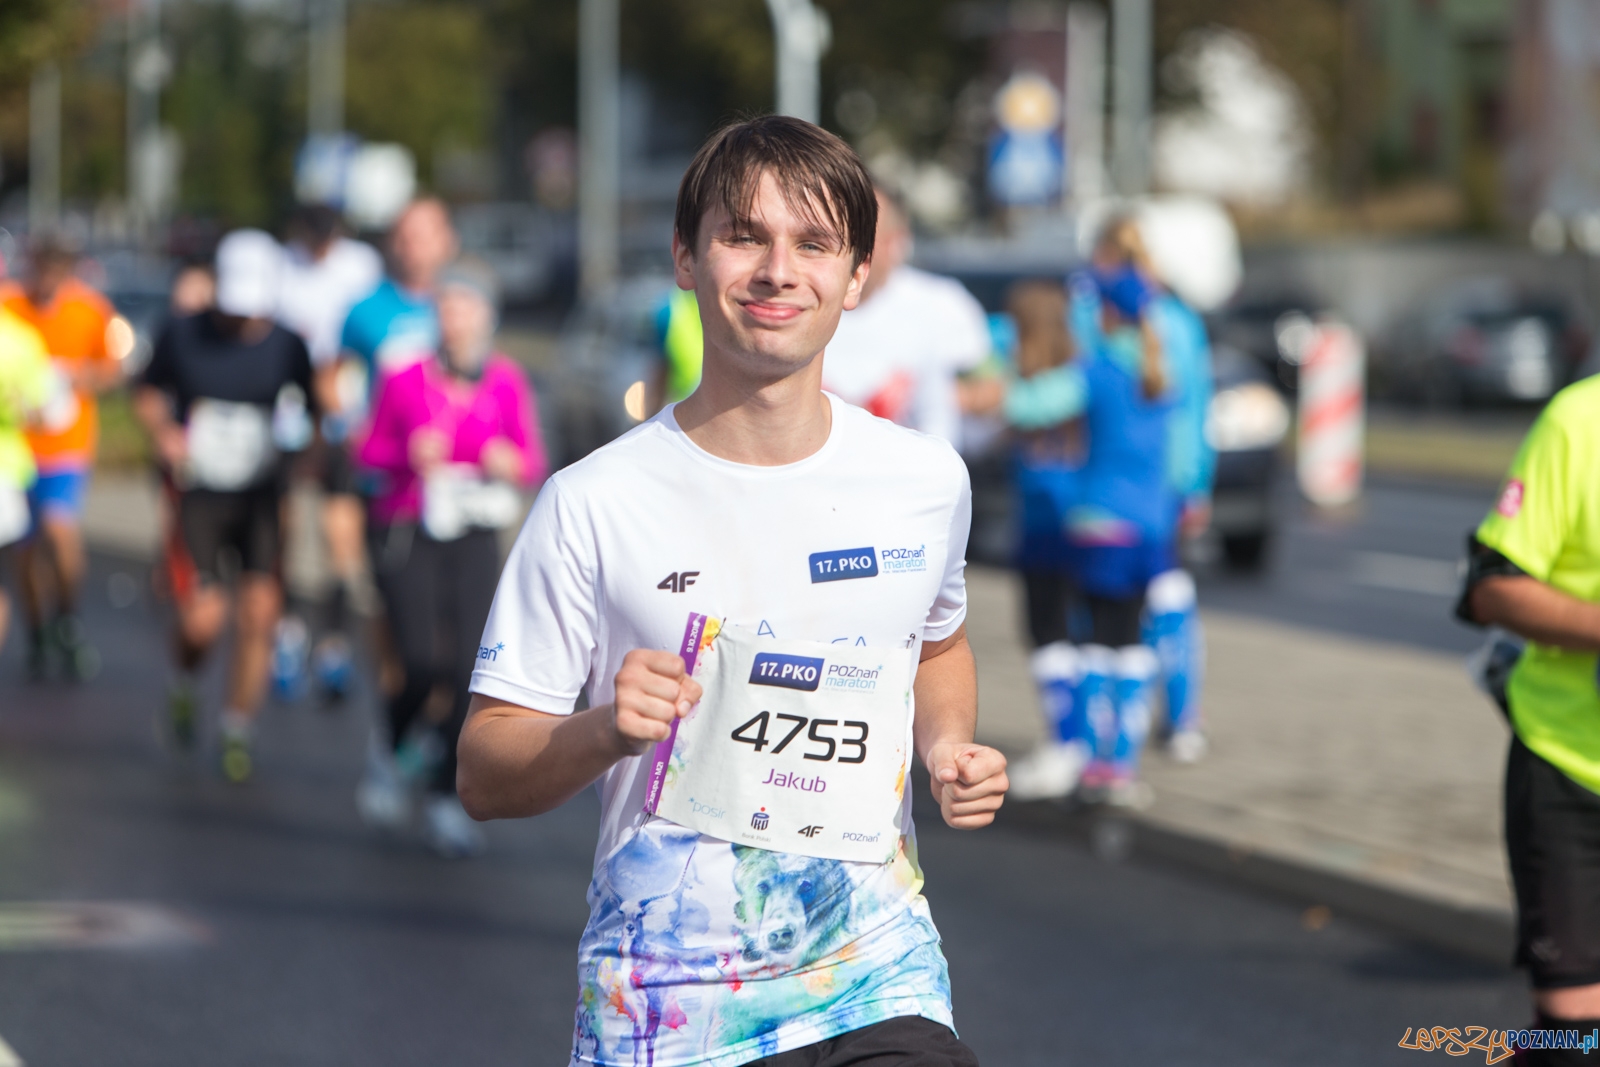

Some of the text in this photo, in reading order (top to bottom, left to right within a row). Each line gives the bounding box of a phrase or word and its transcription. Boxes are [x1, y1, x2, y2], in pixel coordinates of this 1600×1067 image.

[815, 555, 872, 574] 17. PKO
[883, 557, 926, 570] maraton
[656, 571, 700, 593] 4F
[686, 620, 701, 653] 9.10.201
[759, 661, 817, 682] 17. PKO
[824, 676, 877, 690] maraton
[730, 710, 869, 764] 4753
[762, 768, 827, 793] Jakub
[692, 800, 727, 819] posir
[797, 825, 824, 838] 4F
